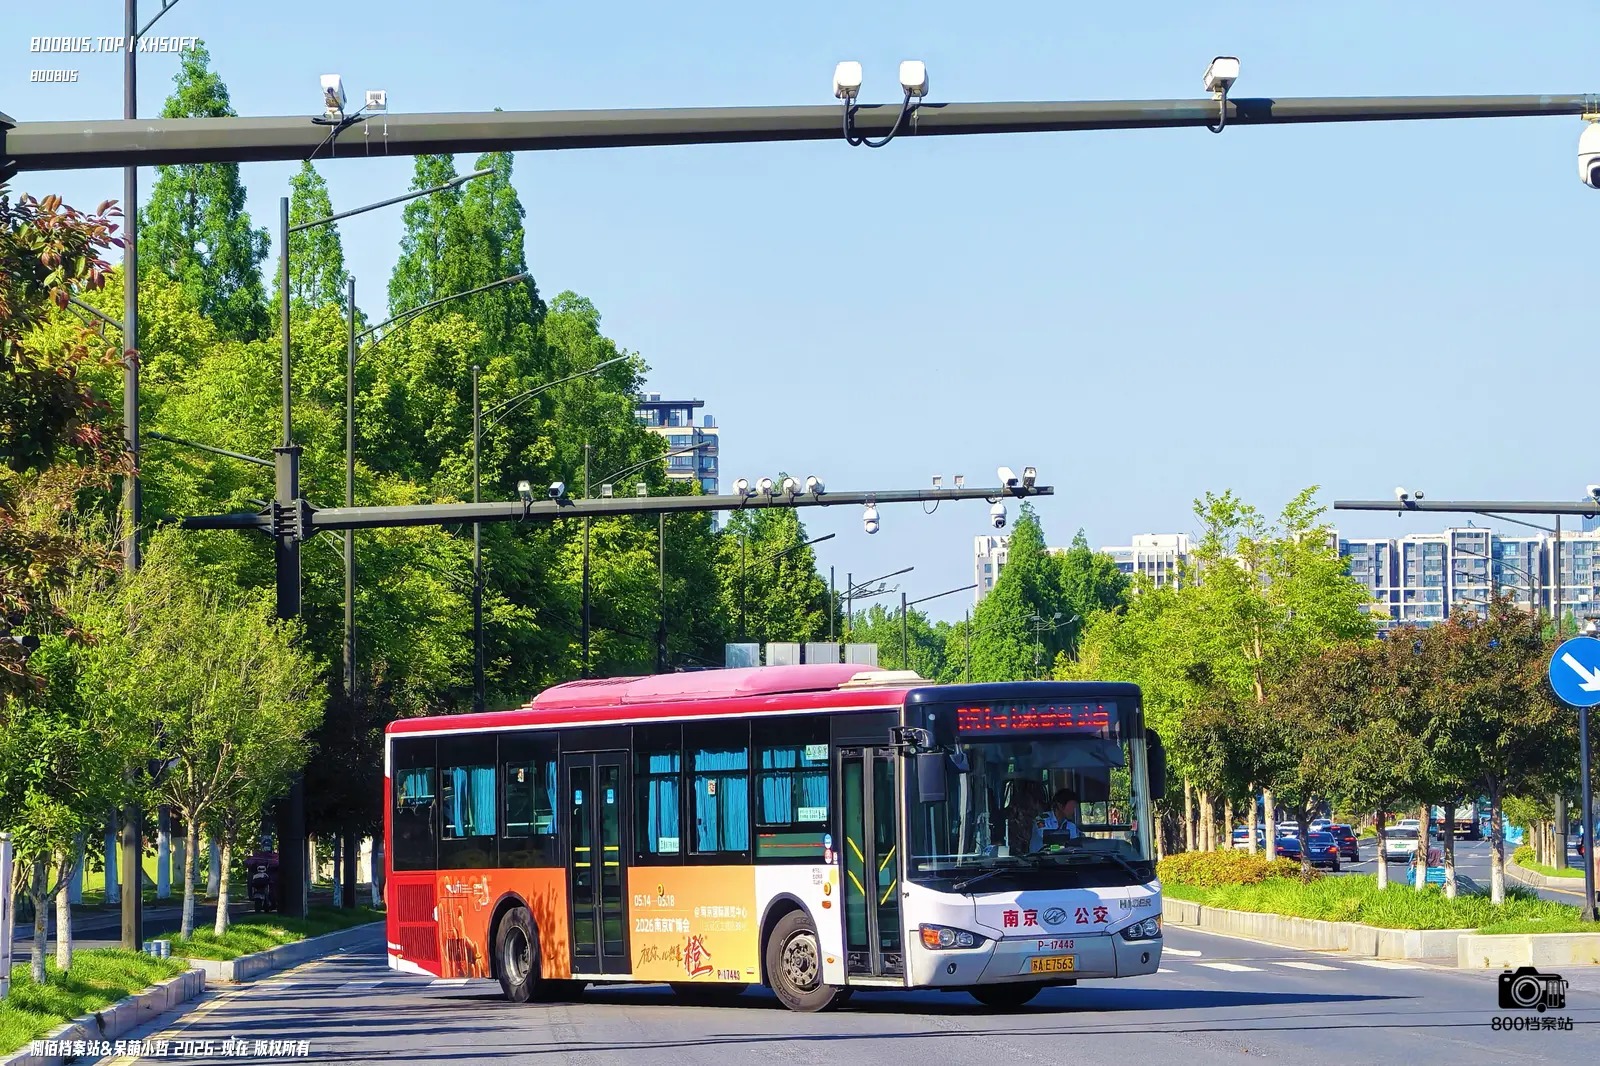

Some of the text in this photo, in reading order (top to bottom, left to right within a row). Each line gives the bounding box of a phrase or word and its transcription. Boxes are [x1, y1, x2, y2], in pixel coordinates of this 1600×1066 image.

[1003, 906, 1109, 928] 南京 公交
[1038, 939, 1075, 951] P-17443
